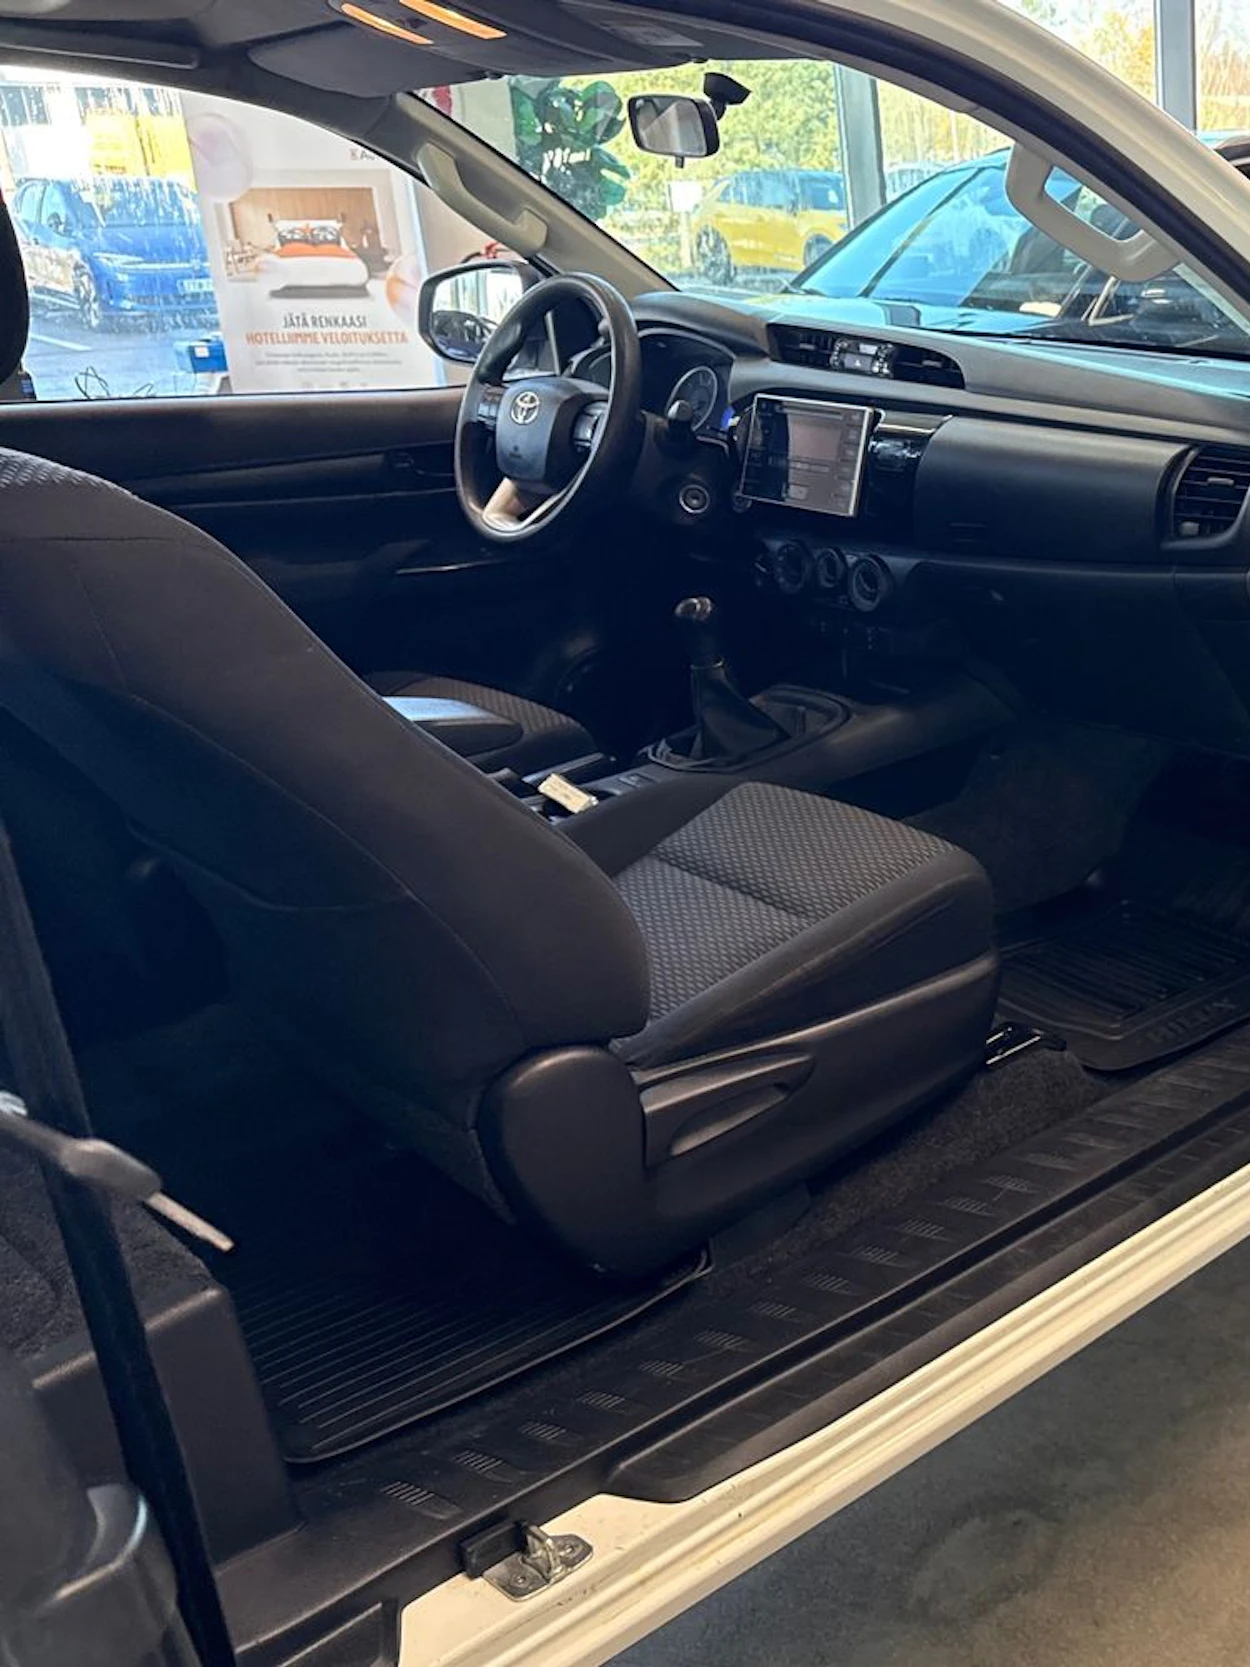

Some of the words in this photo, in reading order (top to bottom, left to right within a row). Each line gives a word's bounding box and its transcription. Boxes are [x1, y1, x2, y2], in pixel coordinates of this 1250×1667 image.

[283, 312, 309, 329] JÄTÄ
[311, 315, 367, 328] RENKAASI
[323, 331, 408, 344] VELOITUKSETTA
